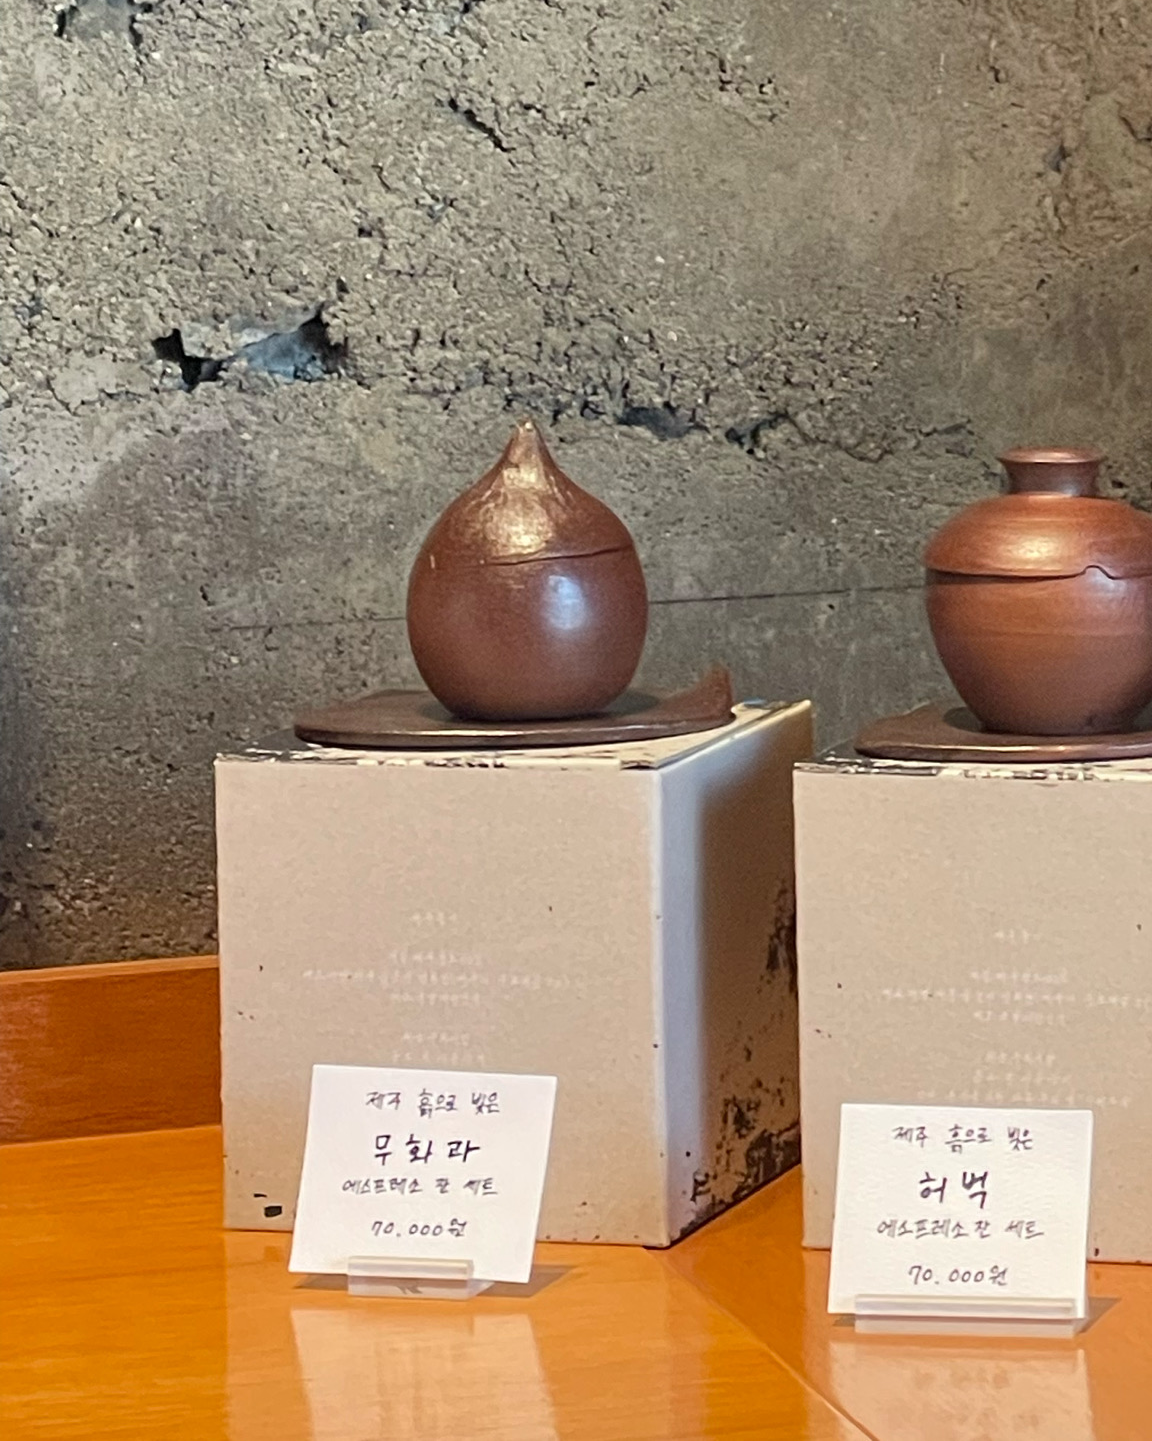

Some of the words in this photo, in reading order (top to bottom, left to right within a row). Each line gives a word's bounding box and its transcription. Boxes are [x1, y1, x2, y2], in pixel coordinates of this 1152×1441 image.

[365, 1090, 402, 1111] 제주
[891, 1125, 930, 1149] 제주
[917, 1170, 989, 1211] 허벅
[973, 1219, 992, 1240] 잔
